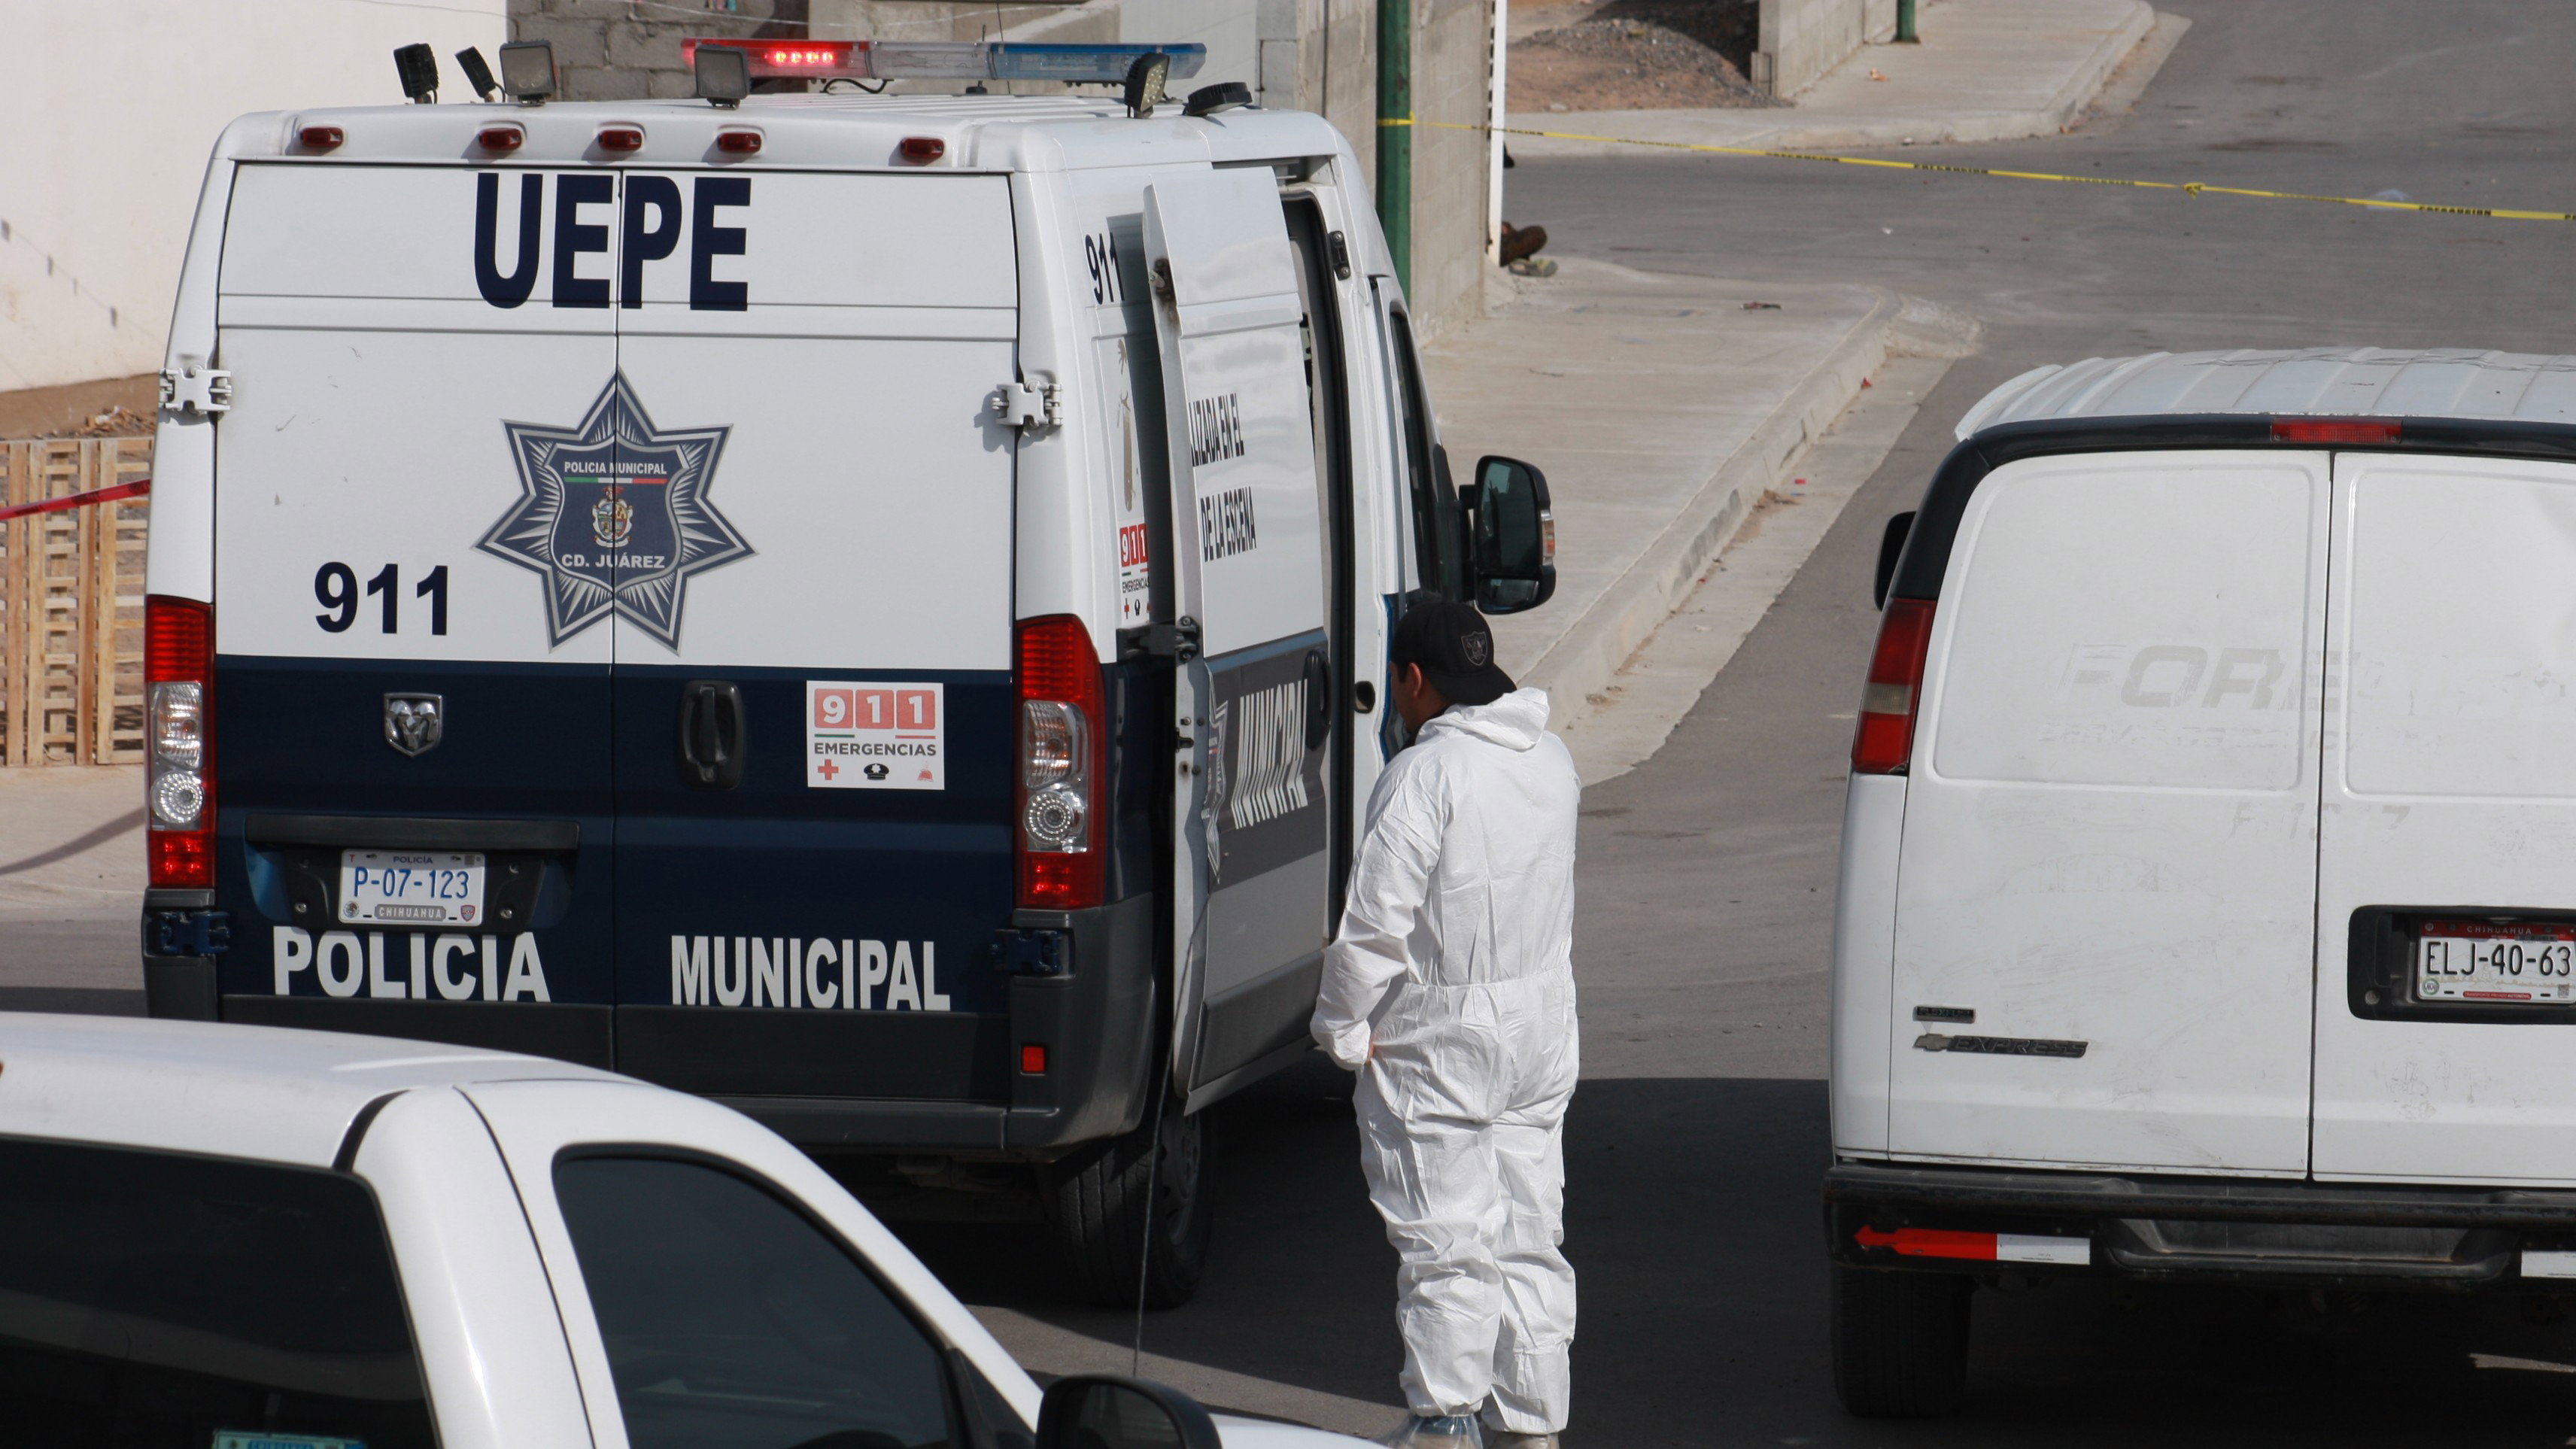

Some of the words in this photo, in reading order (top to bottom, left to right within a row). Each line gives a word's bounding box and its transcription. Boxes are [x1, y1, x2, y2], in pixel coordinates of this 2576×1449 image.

[474, 172, 752, 311] UEPE
[1085, 232, 1124, 305] 911
[1189, 397, 1222, 466] LIZADA
[1218, 395, 1234, 459] EN
[1230, 393, 1244, 457] EL
[564, 461, 606, 473] POLICIA
[609, 462, 667, 475] MUNICIPAL
[1200, 497, 1214, 562] DE
[1212, 493, 1226, 559] LA
[1223, 486, 1256, 555] ESCENA
[561, 554, 590, 567] CD.
[595, 551, 665, 569] JUÁREZ
[1121, 529, 1146, 562] 911
[314, 561, 448, 636] 911
[822, 694, 924, 724] 911
[814, 742, 937, 756] EMERGENCIAS
[1231, 679, 1308, 829] MUNICIPAL
[354, 867, 469, 898] P-07-123
[378, 904, 442, 918] CHIHUAHUA
[2467, 926, 2532, 934] CHIHUAHUA
[273, 925, 551, 1003] POLICIA
[671, 935, 951, 1011] MUNICIPAL
[2427, 942, 2571, 977] ELJ-40-63
[1955, 1037, 2086, 1055] EXPRESS
